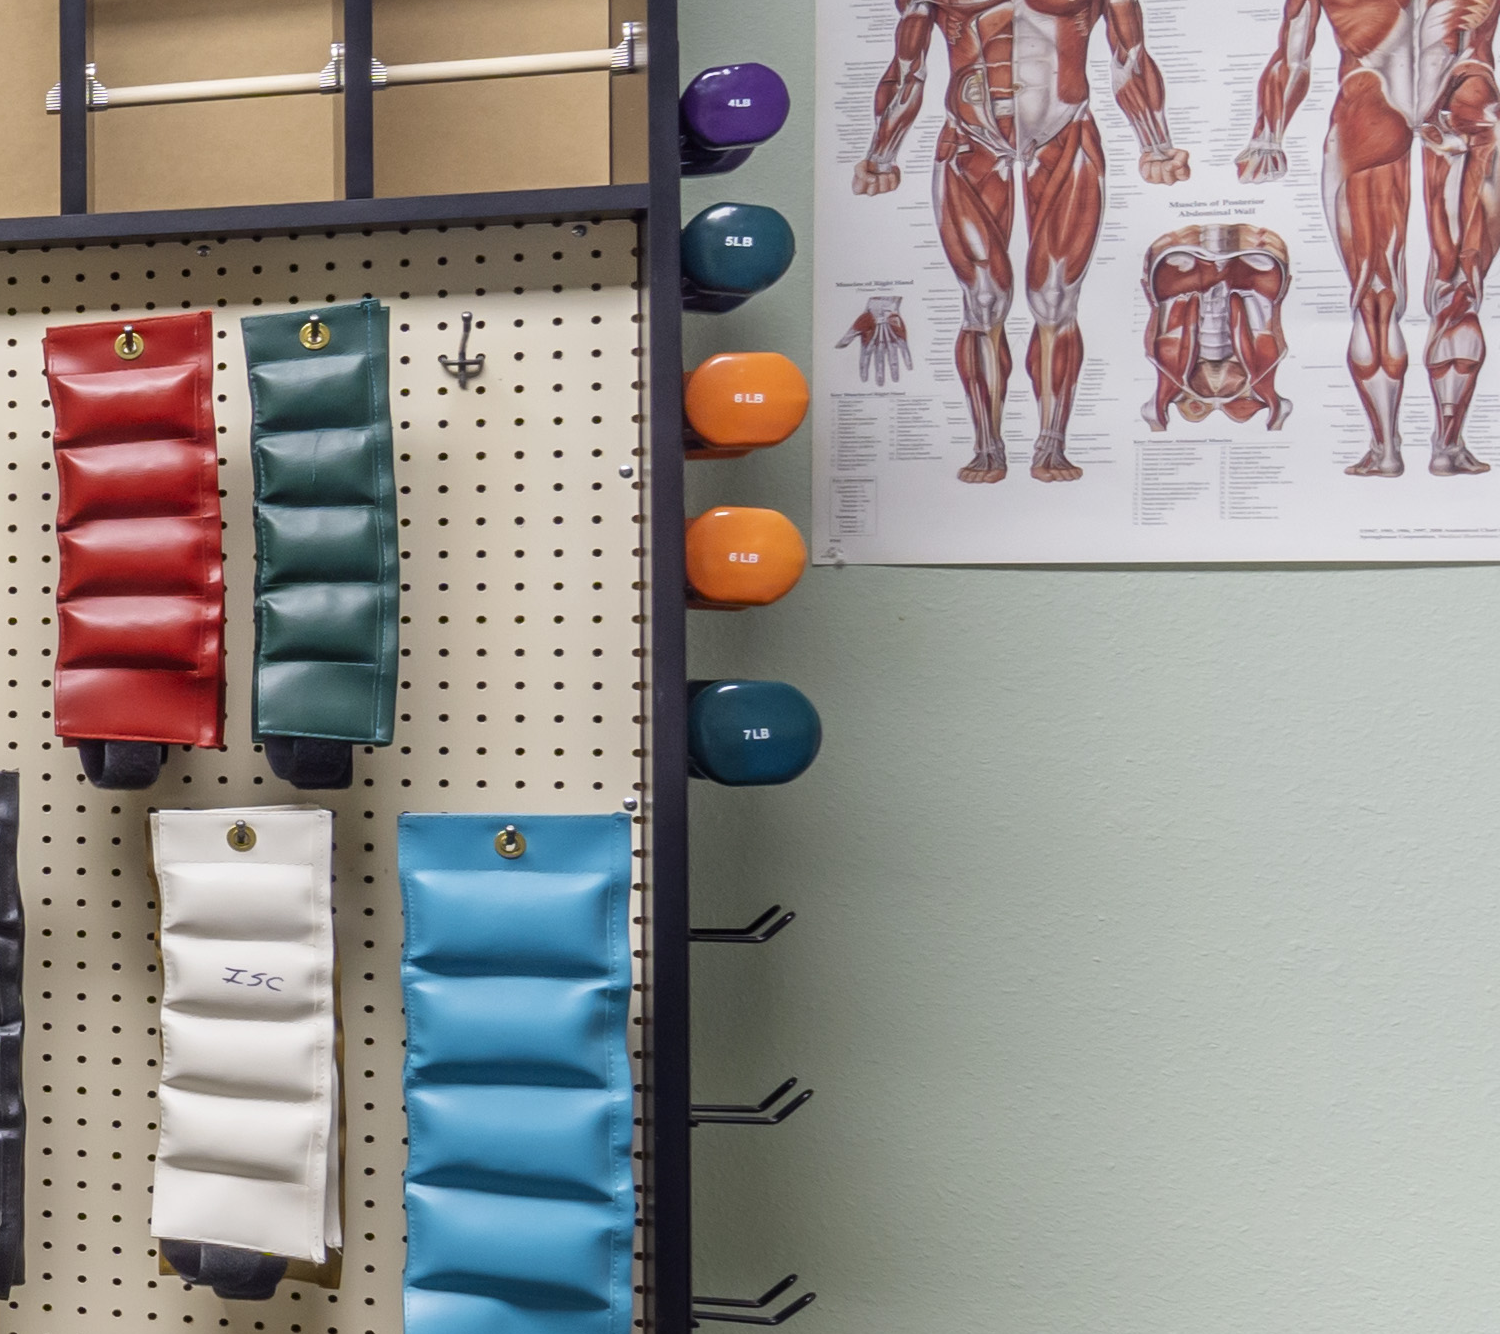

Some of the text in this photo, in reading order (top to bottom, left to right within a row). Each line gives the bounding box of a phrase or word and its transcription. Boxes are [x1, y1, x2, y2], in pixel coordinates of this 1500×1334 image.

[1169, 200, 1208, 208] Muscles
[1222, 198, 1265, 206] Posterior
[1178, 209, 1231, 217] Abdominal
